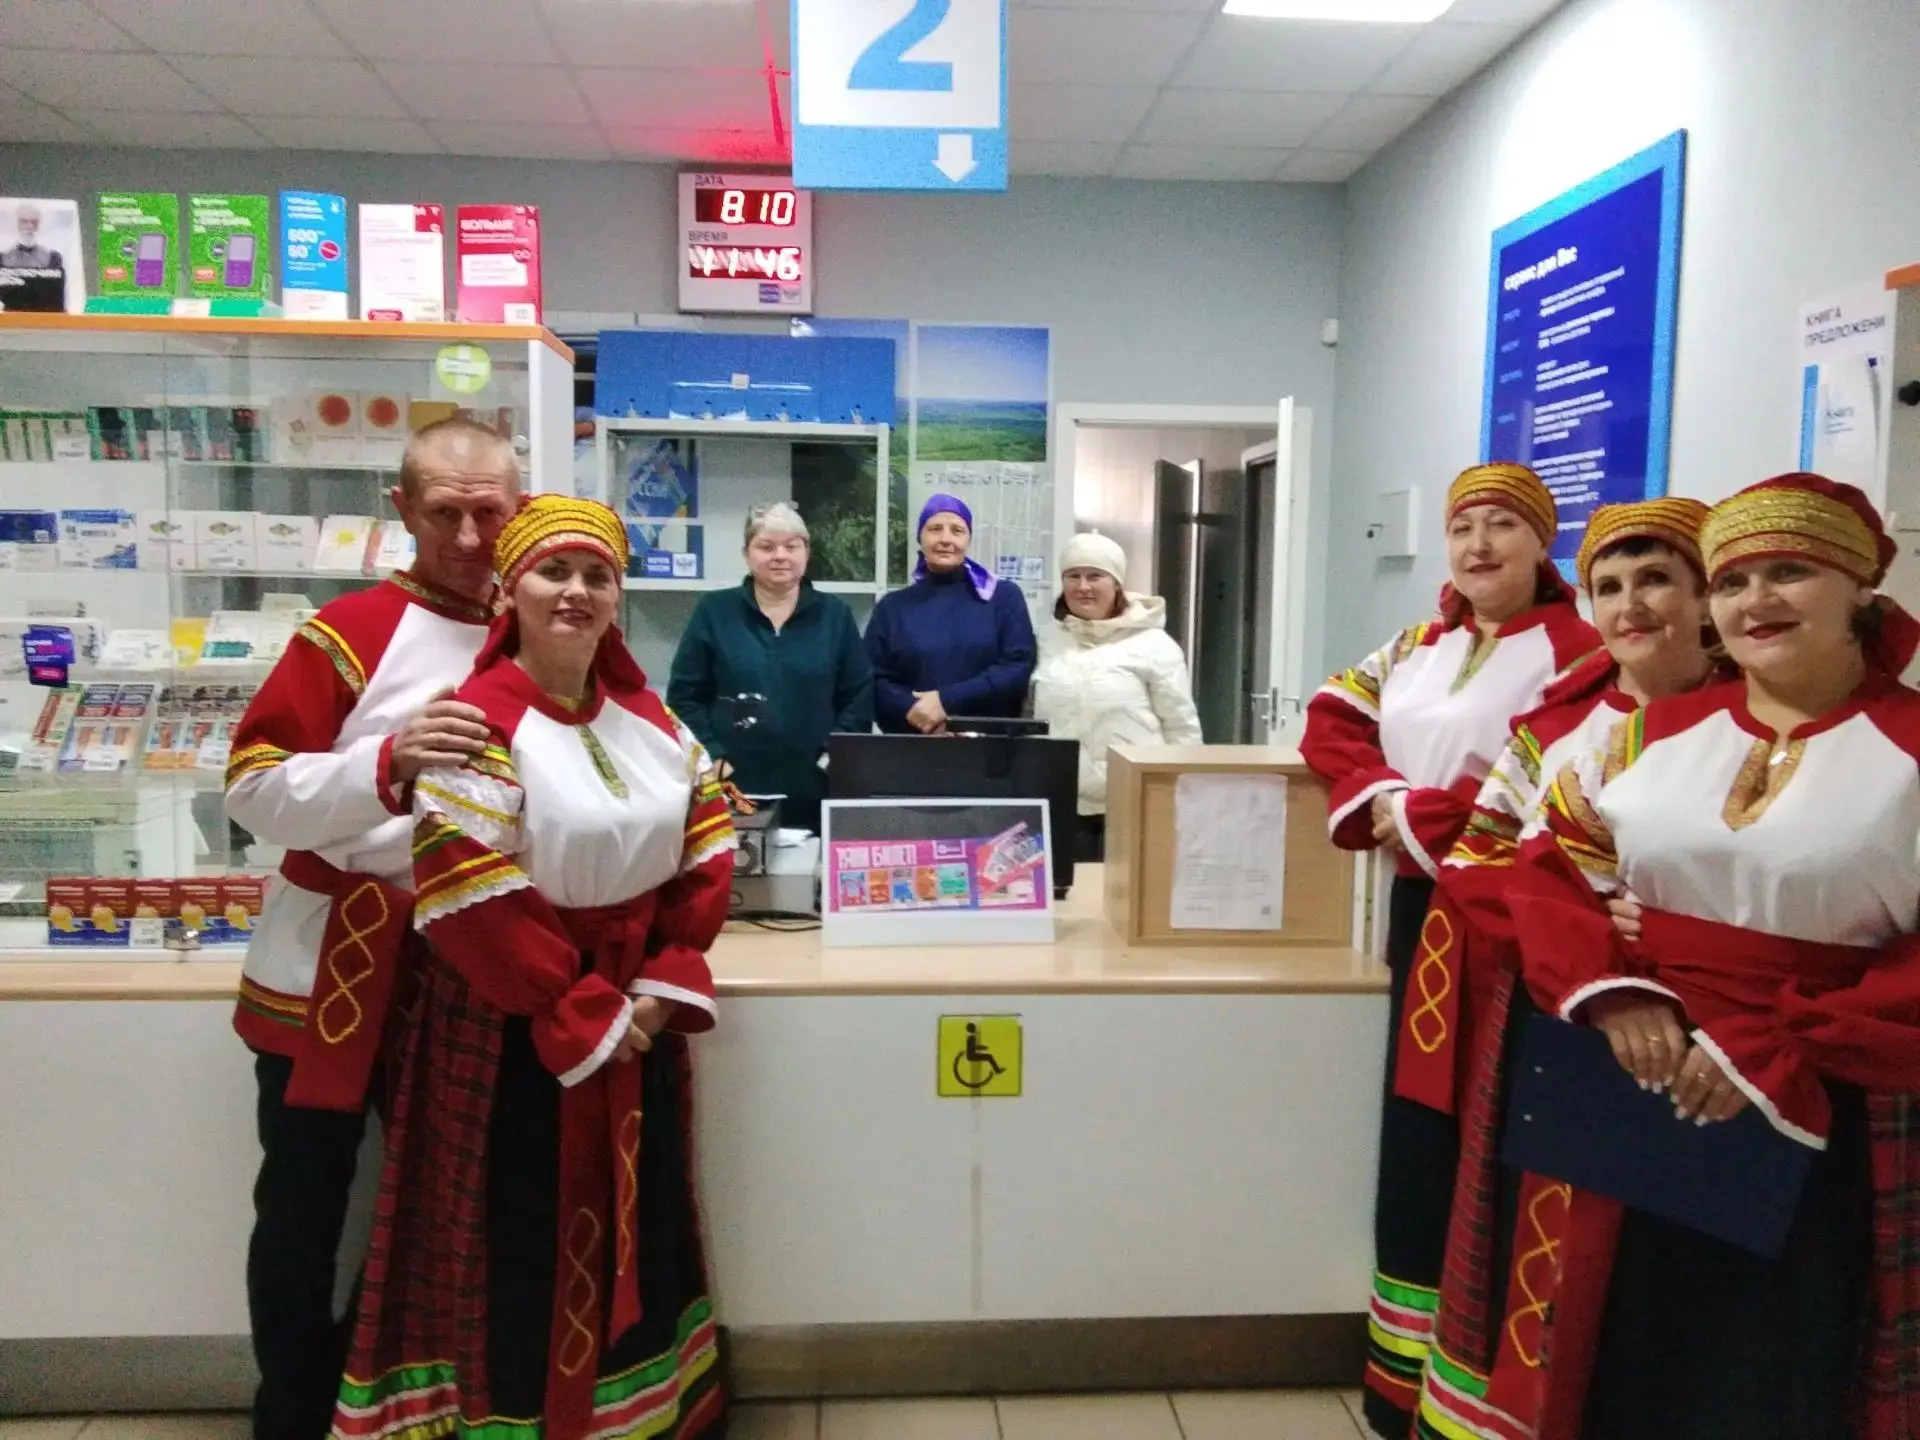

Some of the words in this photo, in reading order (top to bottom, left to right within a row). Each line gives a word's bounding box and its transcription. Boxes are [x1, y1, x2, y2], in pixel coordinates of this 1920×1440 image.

[847, 0, 953, 92] 2
[694, 174, 725, 186] ДАТА
[688, 230, 728, 241] ВРЕМЯ
[1806, 306, 1842, 326] КНИГА
